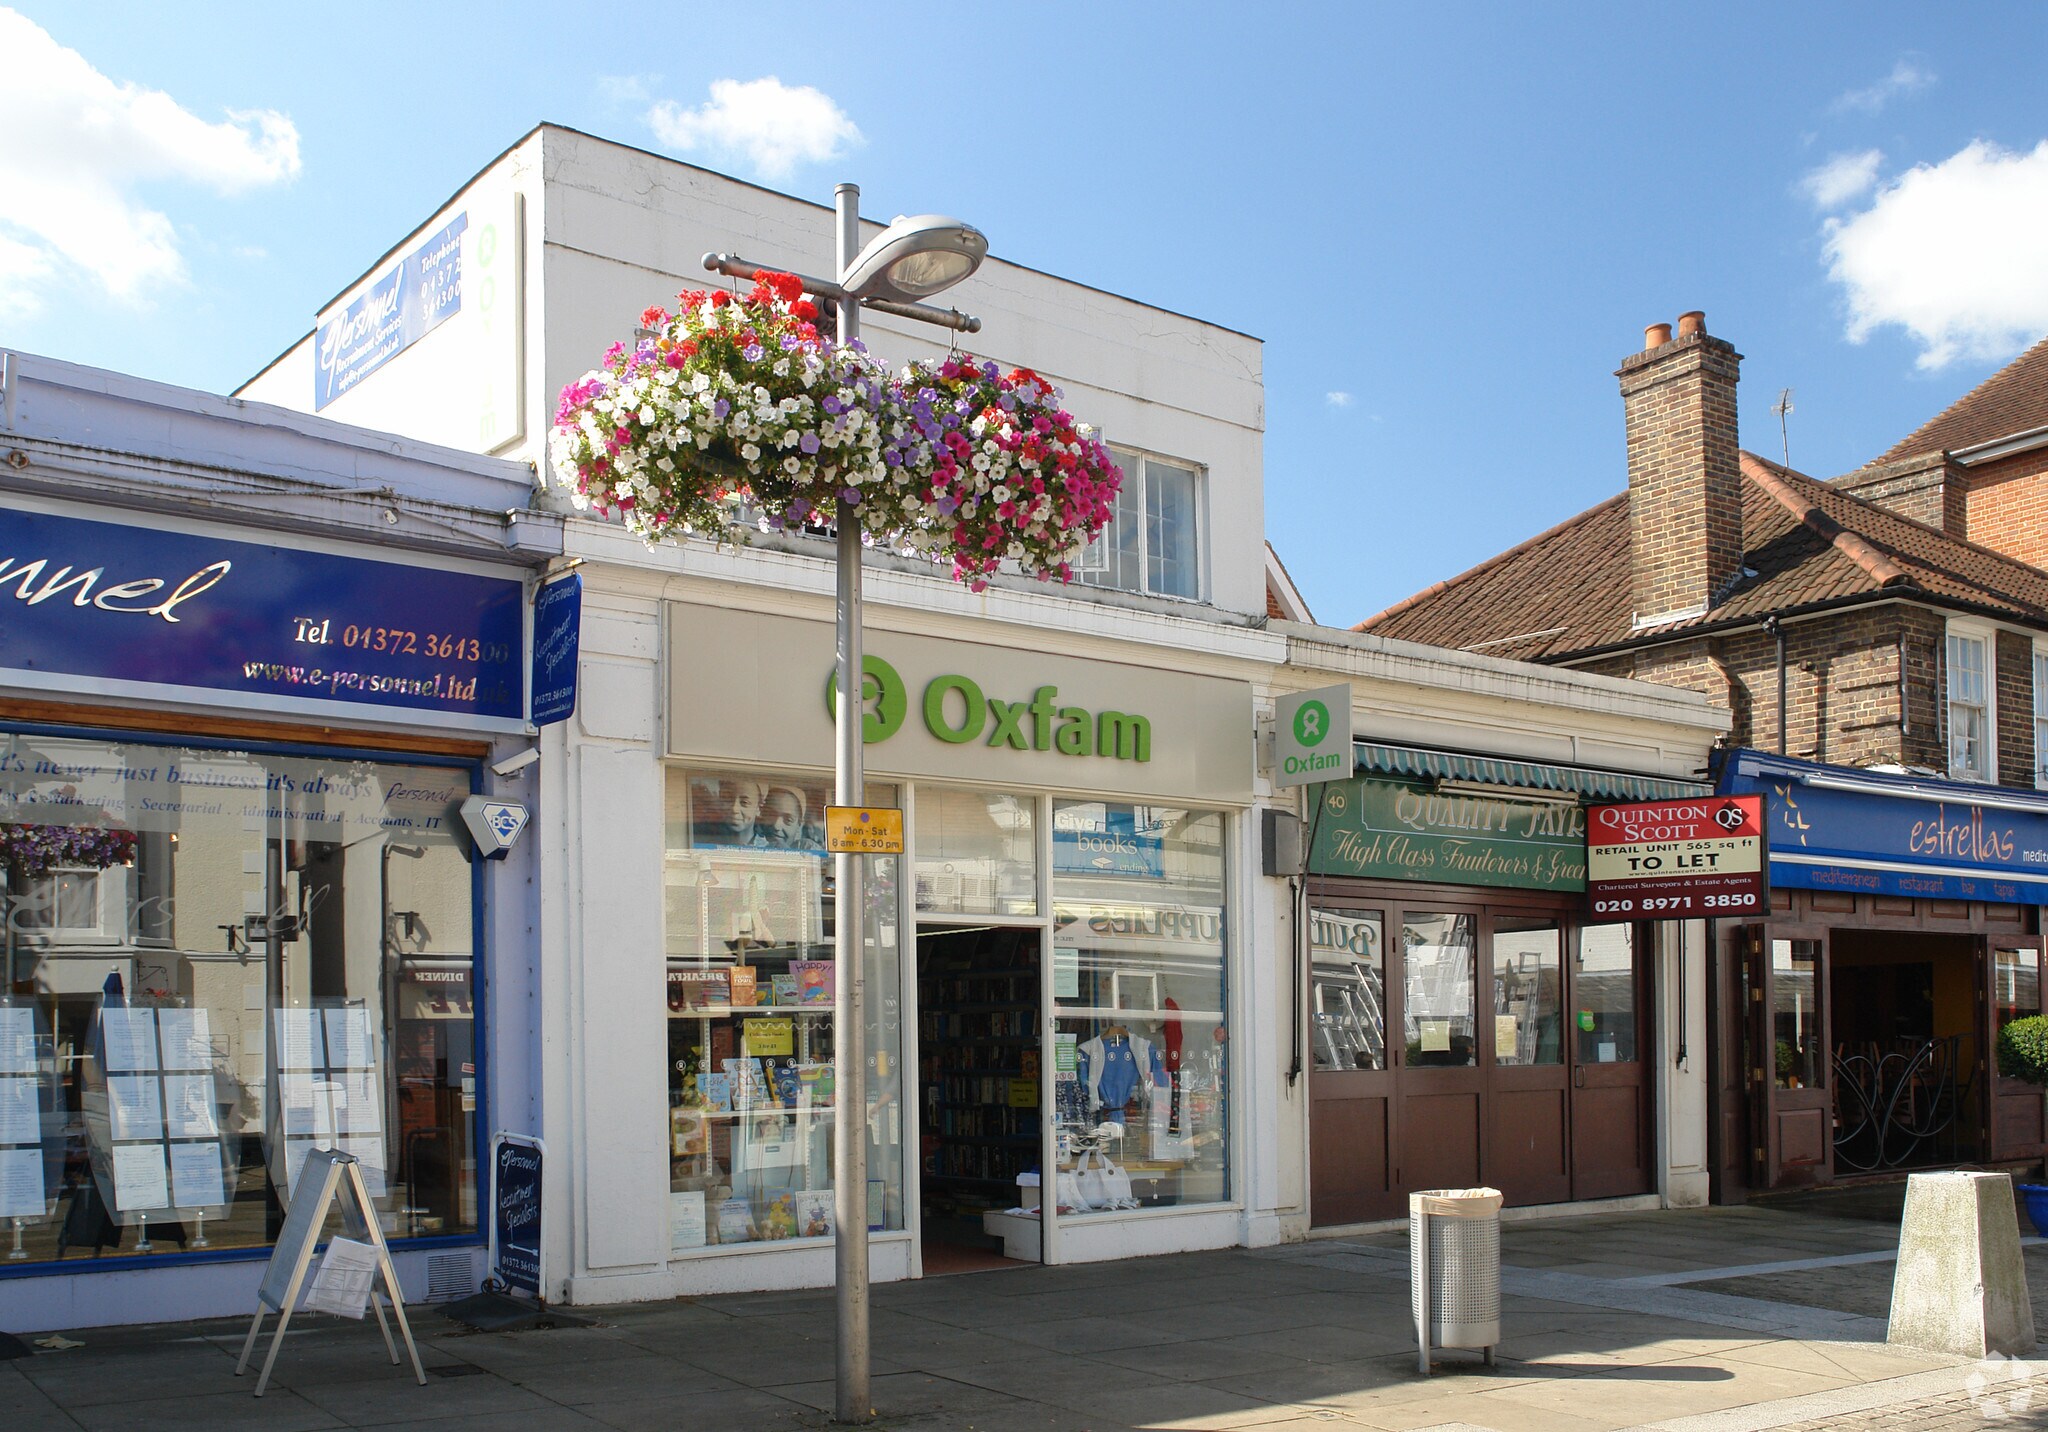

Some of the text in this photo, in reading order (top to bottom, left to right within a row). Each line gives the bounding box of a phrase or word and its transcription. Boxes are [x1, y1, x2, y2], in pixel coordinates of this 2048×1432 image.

[375, 315, 403, 346] Services
[293, 616, 333, 645] Tel.
[343, 624, 417, 655] 01372
[922, 674, 1152, 763] Oxfam
[1283, 752, 1340, 775] Oxfam
[35, 760, 102, 777] never
[112, 761, 158, 784] just
[167, 764, 260, 791] business
[266, 772, 296, 792] it's
[303, 776, 373, 801] always
[1327, 795, 1345, 809] 40
[1394, 787, 1515, 832] QUALITY
[354, 813, 413, 829] Accounts
[426, 817, 443, 829] IT
[492, 815, 519, 830] BCS
[1054, 812, 1096, 830] Give
[1599, 805, 1709, 829] QUINTON
[1715, 808, 1744, 829] QS
[843, 826, 864, 835] Mon
[871, 826, 888, 836] Sat
[1624, 824, 1699, 842] SCOTT
[1909, 802, 2015, 862] estrellas
[832, 838, 838, 847] 8
[840, 839, 854, 847] am
[861, 838, 884, 848] 6.30
[885, 841, 900, 849] pm
[1077, 830, 1138, 855] books
[1331, 829, 1382, 873] High
[1385, 833, 1435, 868] Class
[1440, 839, 1529, 876] Fruiterers
[1596, 839, 1753, 855] RETAIL UNIT 565 sq ft
[1627, 853, 1720, 871] TO LET
[1628, 867, 1719, 877] www.quintonscott.co.uk
[1598, 877, 1752, 891] Chartered Surveyors & Estate Agents
[1811, 867, 1881, 889] mediterranean
[1898, 875, 1945, 894] restaurant
[1961, 878, 1976, 895] bar
[1594, 893, 1757, 913] 020 8971 3850
[502, 1256, 519, 1269] 01372
